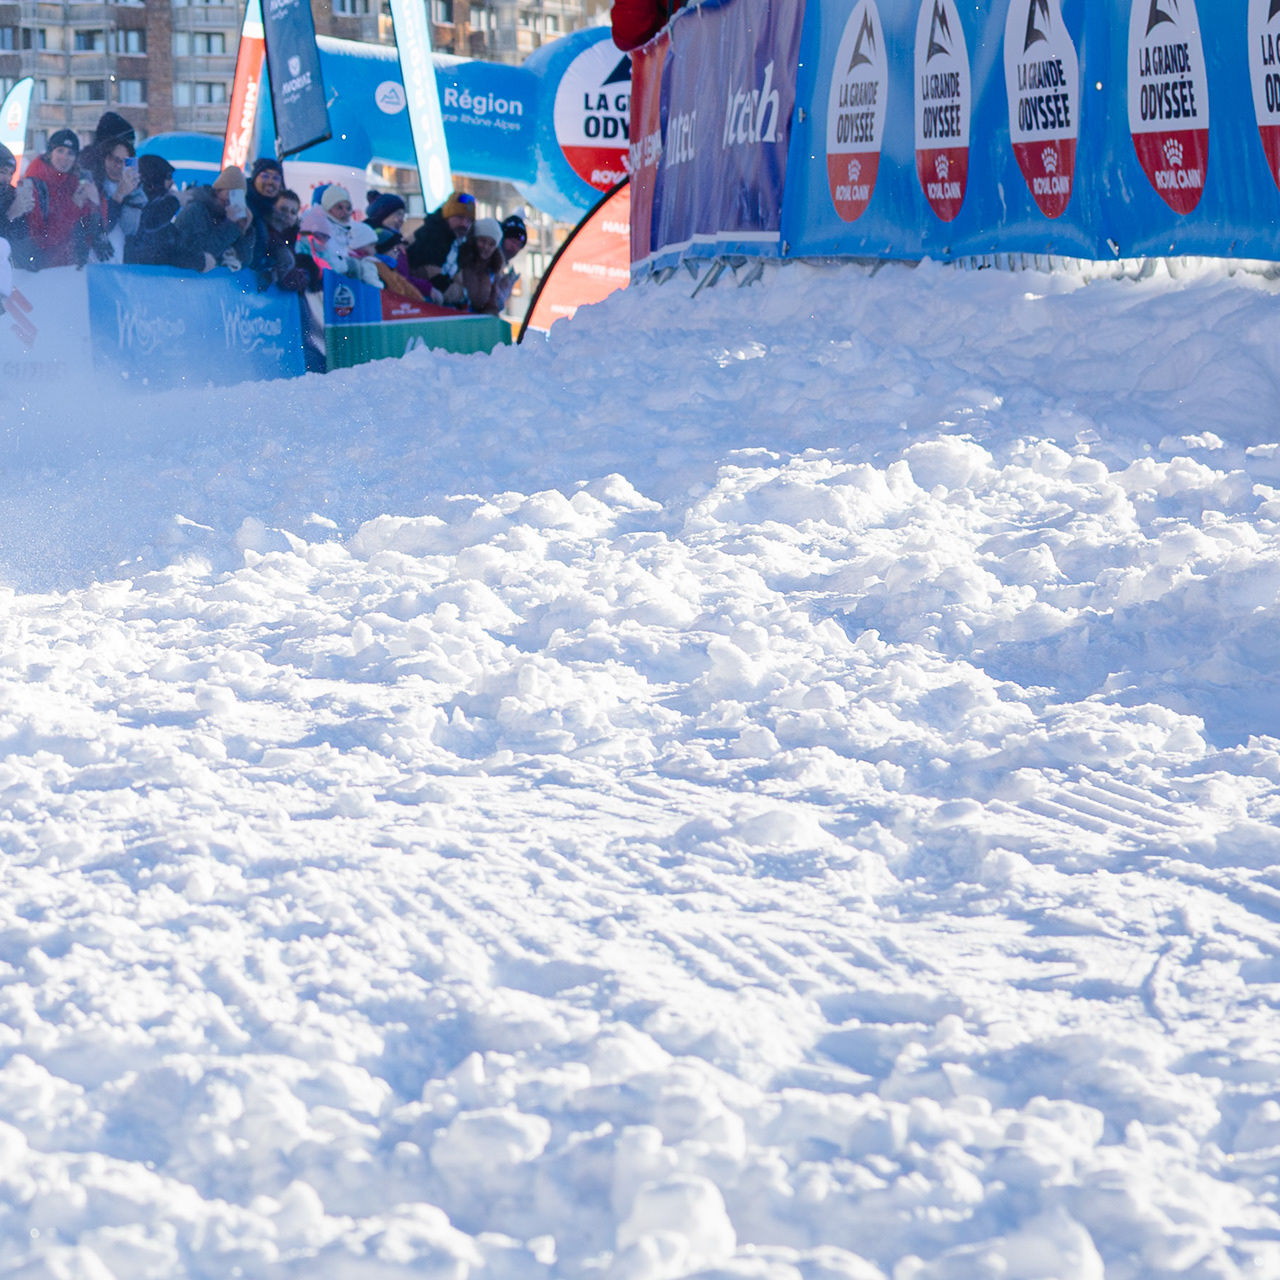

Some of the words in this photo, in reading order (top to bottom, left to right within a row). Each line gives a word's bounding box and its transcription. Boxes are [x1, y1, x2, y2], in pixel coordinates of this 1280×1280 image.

[1139, 47, 1152, 77] LA
[1152, 43, 1192, 75] GRANDE
[1261, 34, 1276, 66] LA
[921, 74, 930, 101] LA
[930, 71, 961, 100] GRANDE
[1017, 64, 1027, 91] LA
[1028, 59, 1067, 90] GRANDE
[444, 86, 523, 117] Région
[584, 92, 609, 111] LA
[838, 83, 849, 108] LA
[849, 80, 880, 107] GRANDE
[1140, 75, 1197, 121] ODYSSÉE
[836, 106, 876, 144] ODYSSÉE
[922, 99, 962, 140] ODYSSÉE
[1018, 89, 1071, 132] ODYSSÉE
